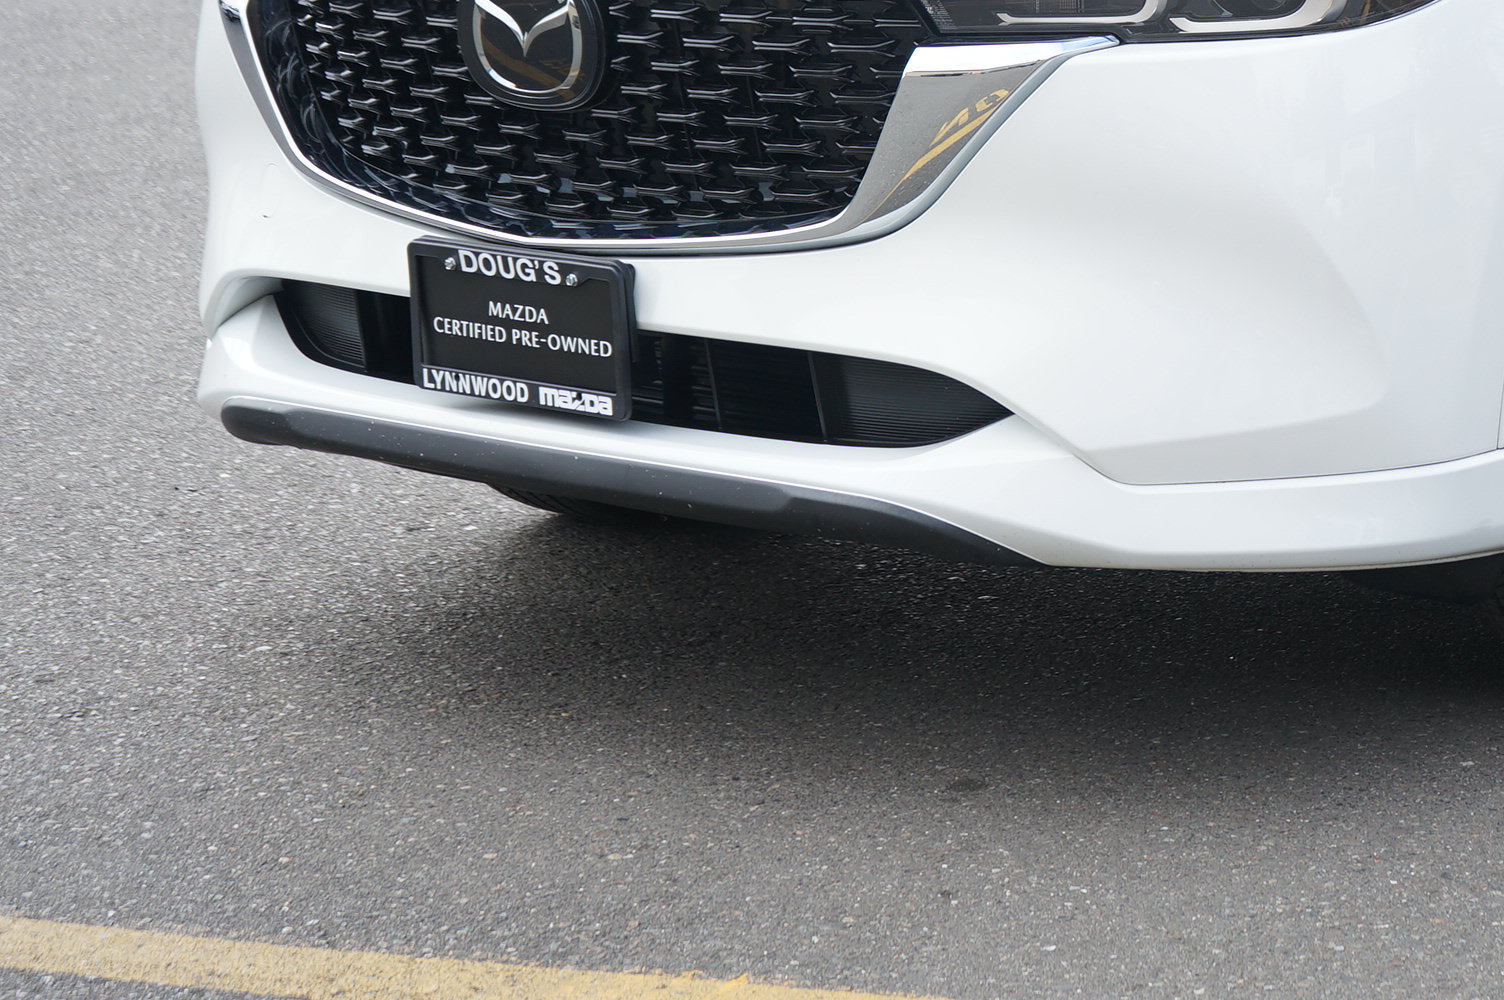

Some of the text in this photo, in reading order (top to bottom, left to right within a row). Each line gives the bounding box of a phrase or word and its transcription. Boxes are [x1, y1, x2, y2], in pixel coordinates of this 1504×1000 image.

[457, 249, 562, 286] DOUG'S
[488, 300, 549, 325] MAZDA
[433, 316, 613, 358] CERTIFIED PRE-OWNED
[422, 367, 529, 403] LYNNWOOD
